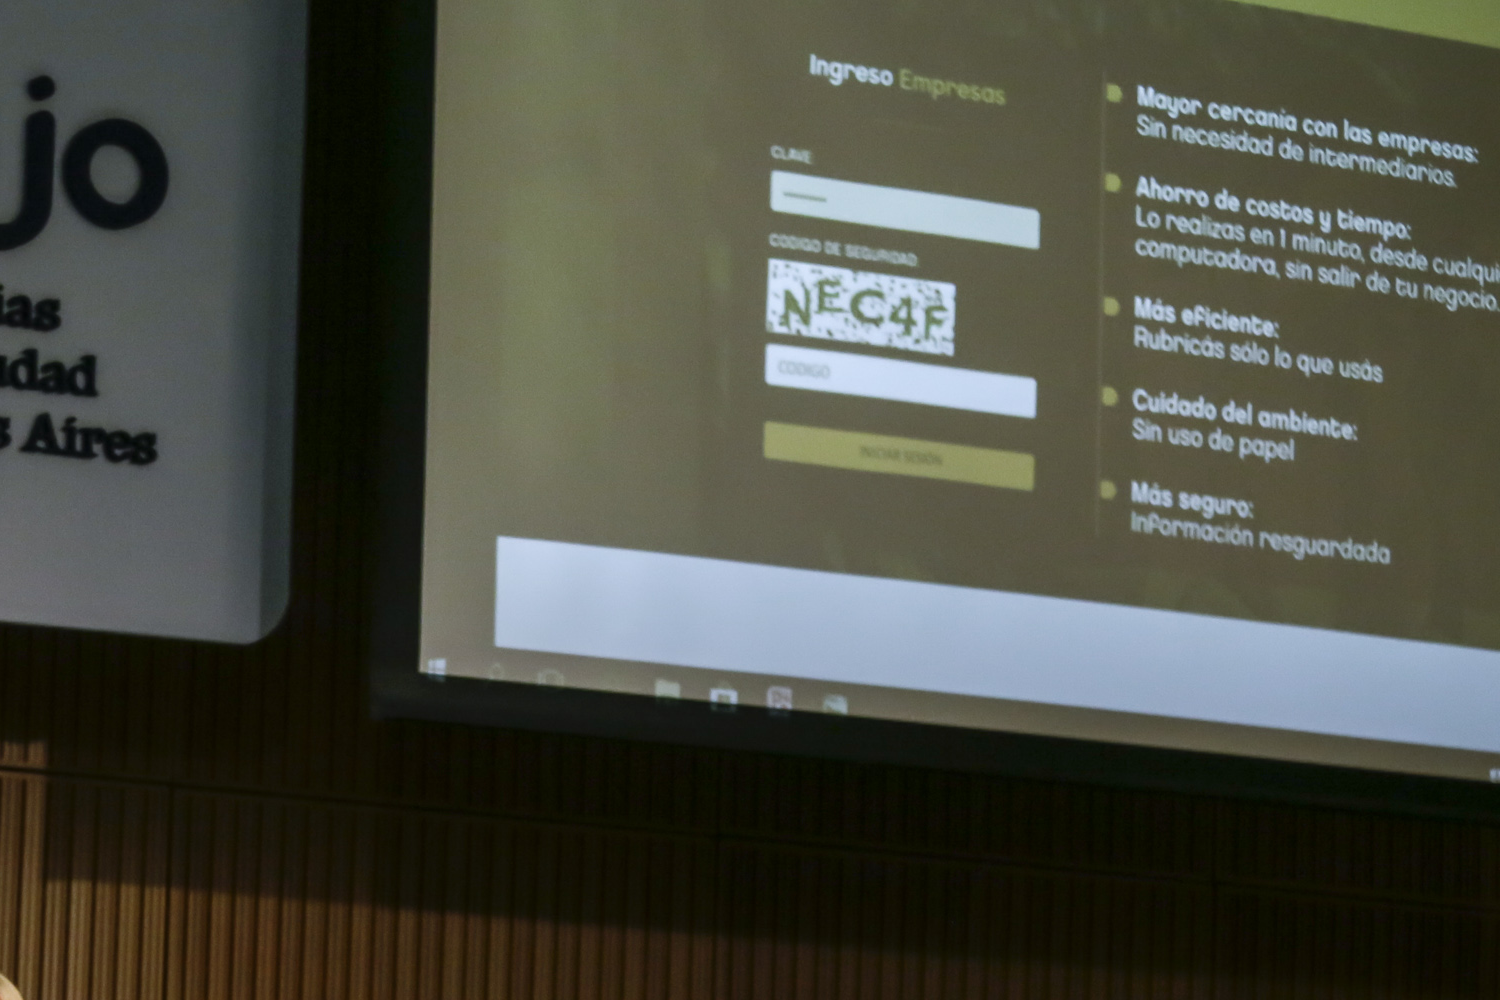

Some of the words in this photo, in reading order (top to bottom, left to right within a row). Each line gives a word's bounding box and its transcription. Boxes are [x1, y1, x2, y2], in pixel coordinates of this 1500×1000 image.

[809, 53, 894, 86] Ingreso
[899, 67, 1006, 106] Empresas
[1136, 84, 1203, 119] Mayor
[1302, 117, 1339, 139] con
[1343, 117, 1373, 146] las
[1377, 130, 1480, 164] empresas:
[1136, 113, 1168, 139] Sin
[1171, 122, 1274, 157] necesidad
[1278, 136, 1305, 162] de
[1135, 175, 1211, 209] Ahorro
[1214, 187, 1241, 213] de
[1245, 197, 1315, 226] costos
[1318, 209, 1332, 234] y
[1337, 207, 1413, 243] tiempo:
[1134, 203, 1162, 229] Lo
[1165, 213, 1247, 242] realizas
[1249, 226, 1276, 247] en
[1292, 231, 1366, 264] minuto,
[1369, 241, 1429, 272] desde
[1134, 237, 1282, 280] computadora,
[1284, 258, 1314, 282] sin
[1317, 263, 1362, 289] salir
[1365, 269, 1391, 295] de
[1395, 276, 1418, 299] tu
[779, 278, 949, 340] NEC4F
[1134, 295, 1177, 324] Más
[1181, 304, 1280, 339] eficiente:
[1274, 343, 1293, 370] lo
[1296, 352, 1335, 379] que
[18, 410, 160, 466] Aires
[1132, 387, 1218, 421] Cuidado
[1221, 398, 1254, 426] del
[1257, 407, 1359, 442] ambiente:
[1132, 415, 1164, 443] Sin
[1167, 425, 1204, 449] uso
[1208, 426, 1235, 453] de
[1238, 436, 1296, 464] papel
[1131, 479, 1174, 508] Más
[1177, 489, 1255, 520] seguro:
[1131, 510, 1254, 549] Información
[1259, 529, 1392, 566] resguardada
